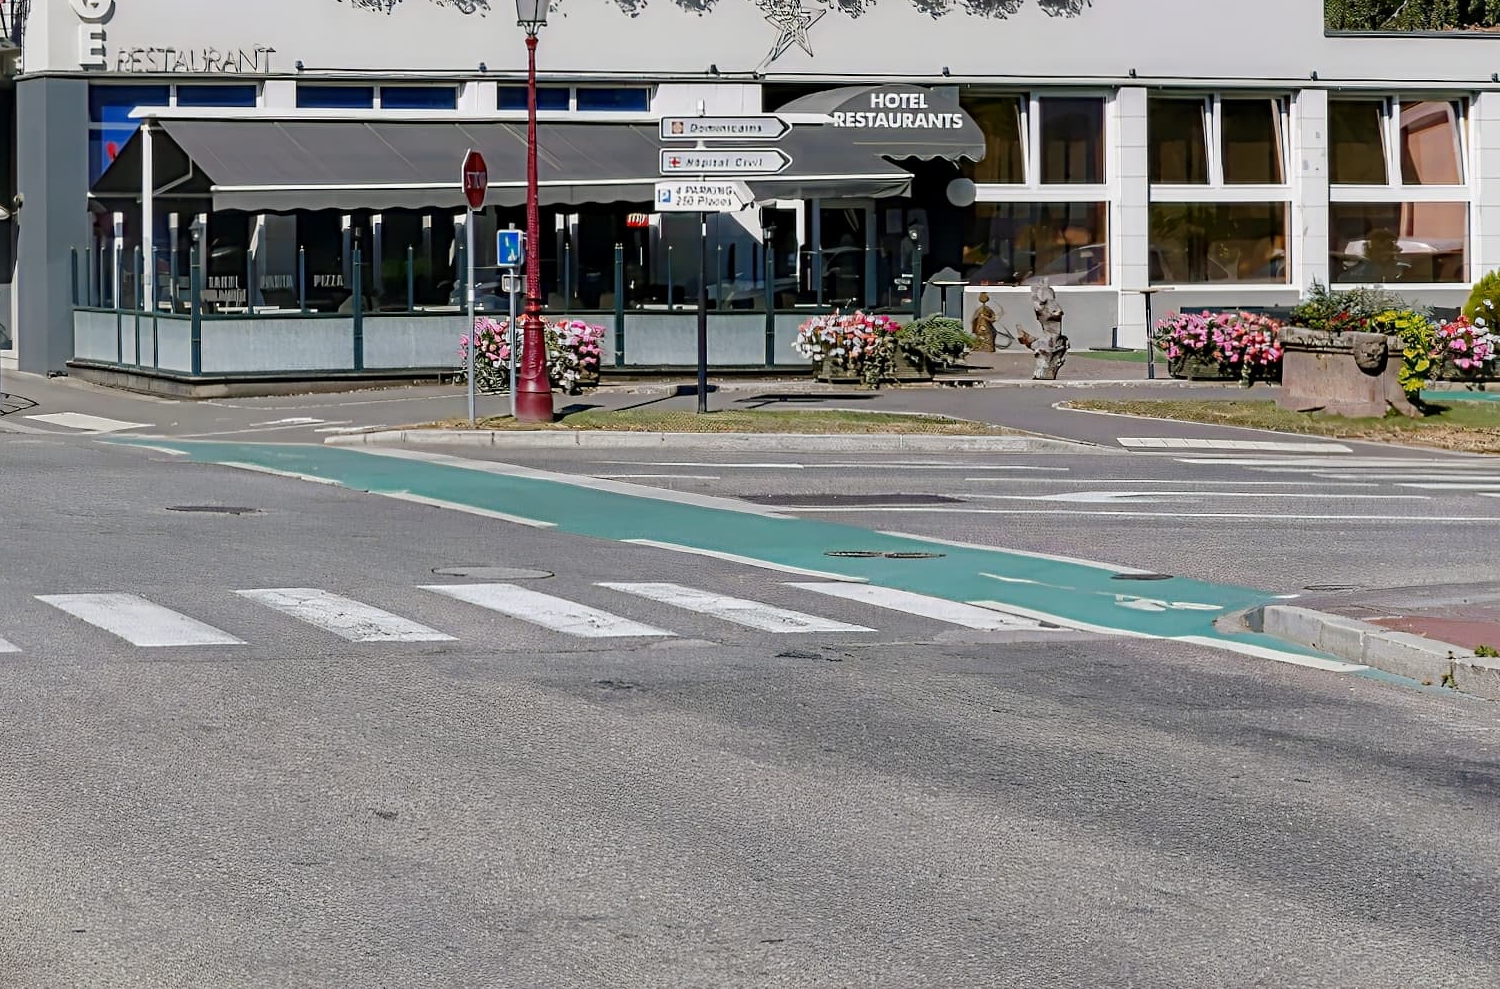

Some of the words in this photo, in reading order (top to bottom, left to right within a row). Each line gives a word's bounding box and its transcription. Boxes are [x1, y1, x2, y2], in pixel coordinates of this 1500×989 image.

[115, 46, 277, 74] RESTAURANT
[870, 93, 929, 109] HOTEL
[690, 122, 763, 133] Dominicains
[833, 111, 964, 129] RESTAURANTS
[313, 274, 344, 288] PIZZA
